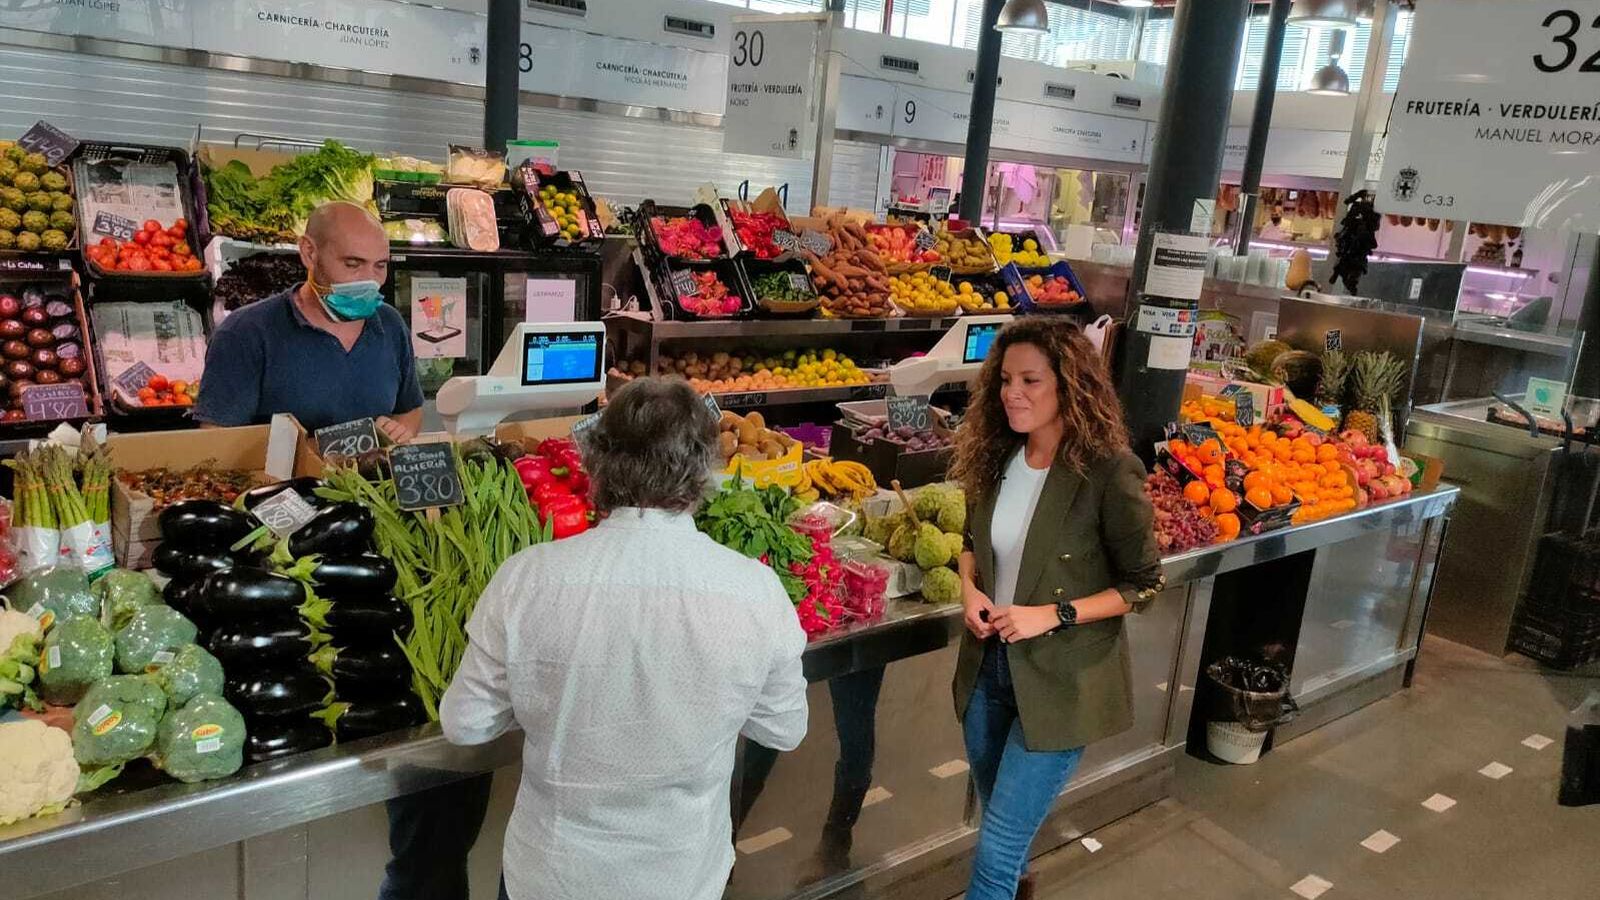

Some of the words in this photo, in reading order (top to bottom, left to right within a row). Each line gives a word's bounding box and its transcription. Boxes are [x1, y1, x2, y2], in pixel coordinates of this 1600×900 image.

[518, 43, 533, 73] 8
[733, 30, 764, 67] 30
[904, 100, 916, 124] 9
[1406, 98, 1481, 118] FRUTERÍA
[1500, 101, 1600, 121] VERDULERÍ
[1475, 127, 1543, 144] MANUEL
[1422, 193, 1455, 208] C-3.3
[399, 473, 454, 505] 3'80
